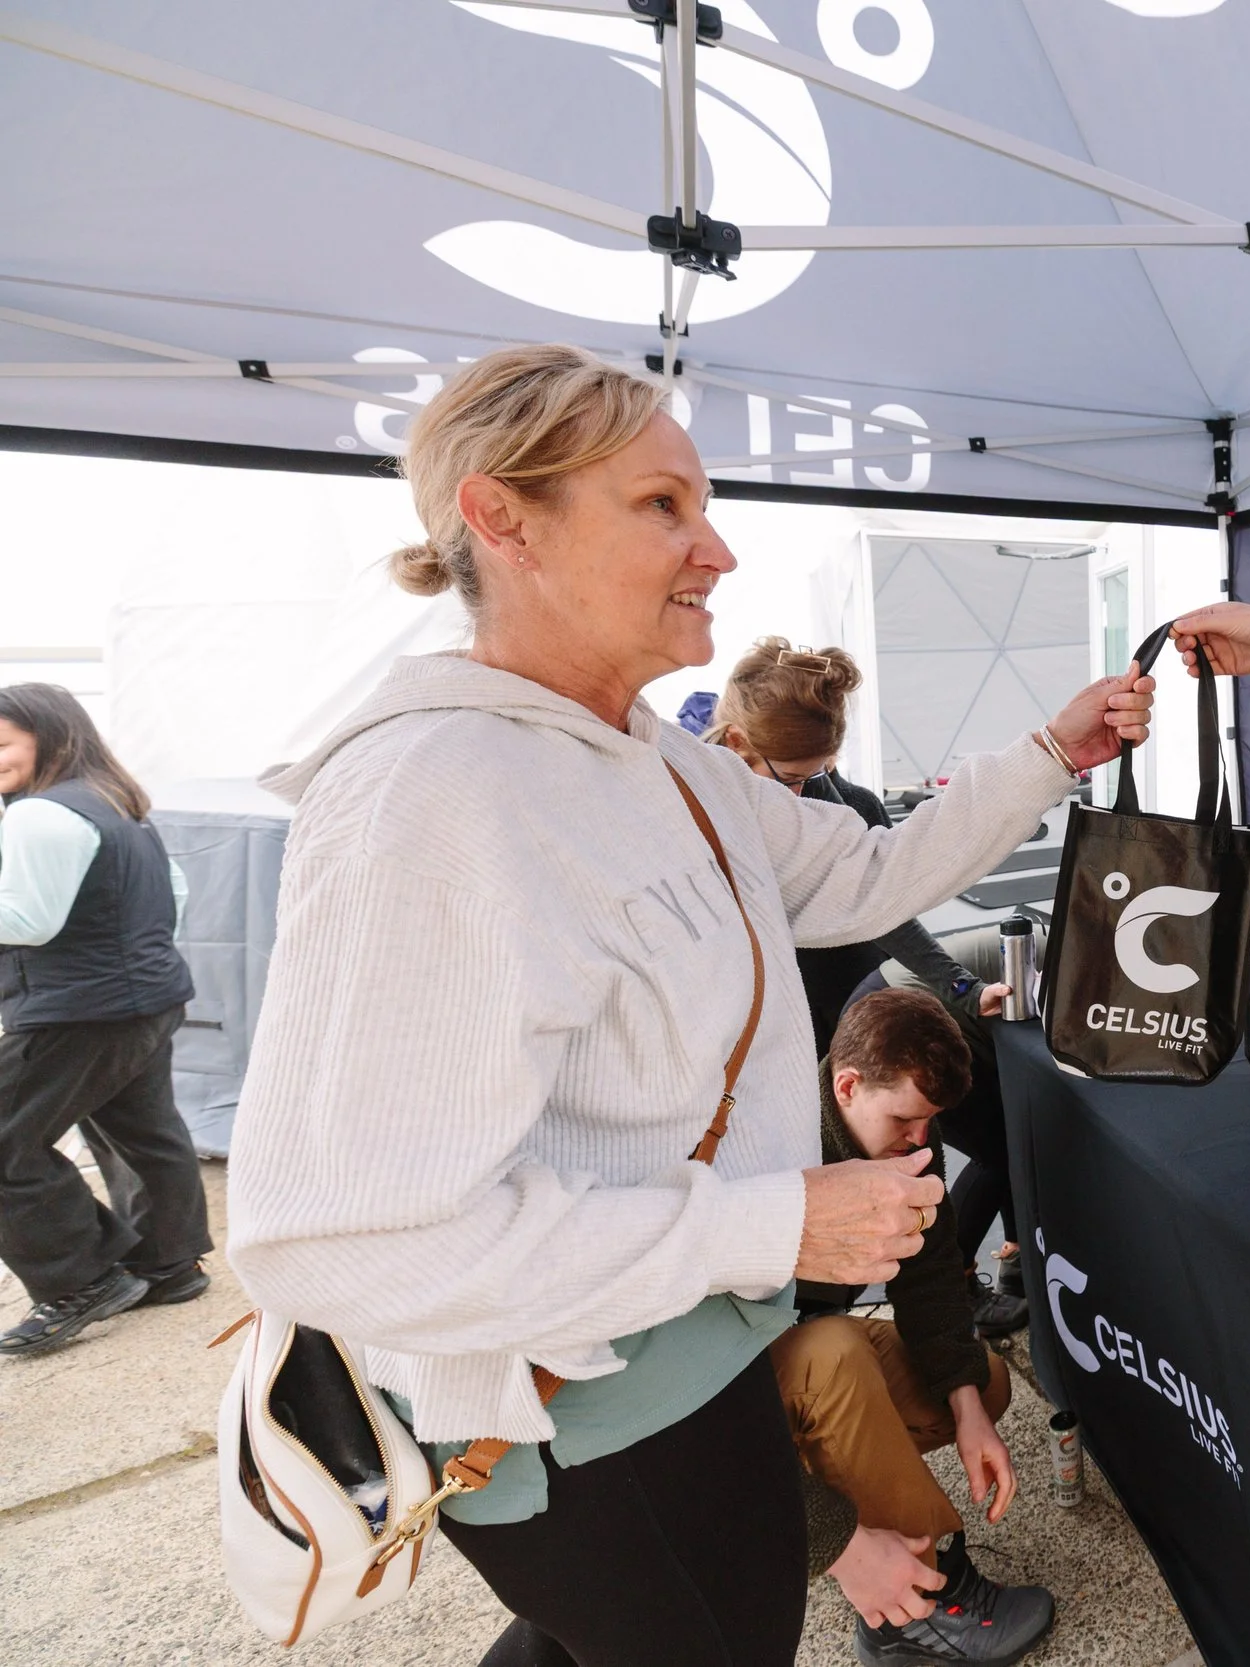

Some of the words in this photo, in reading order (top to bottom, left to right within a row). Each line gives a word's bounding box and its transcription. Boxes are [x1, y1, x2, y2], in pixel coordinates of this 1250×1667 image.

[1157, 1039, 1183, 1051] LIVE
[1185, 1043, 1203, 1056] FIT
[1190, 1423, 1222, 1465] LIVE
